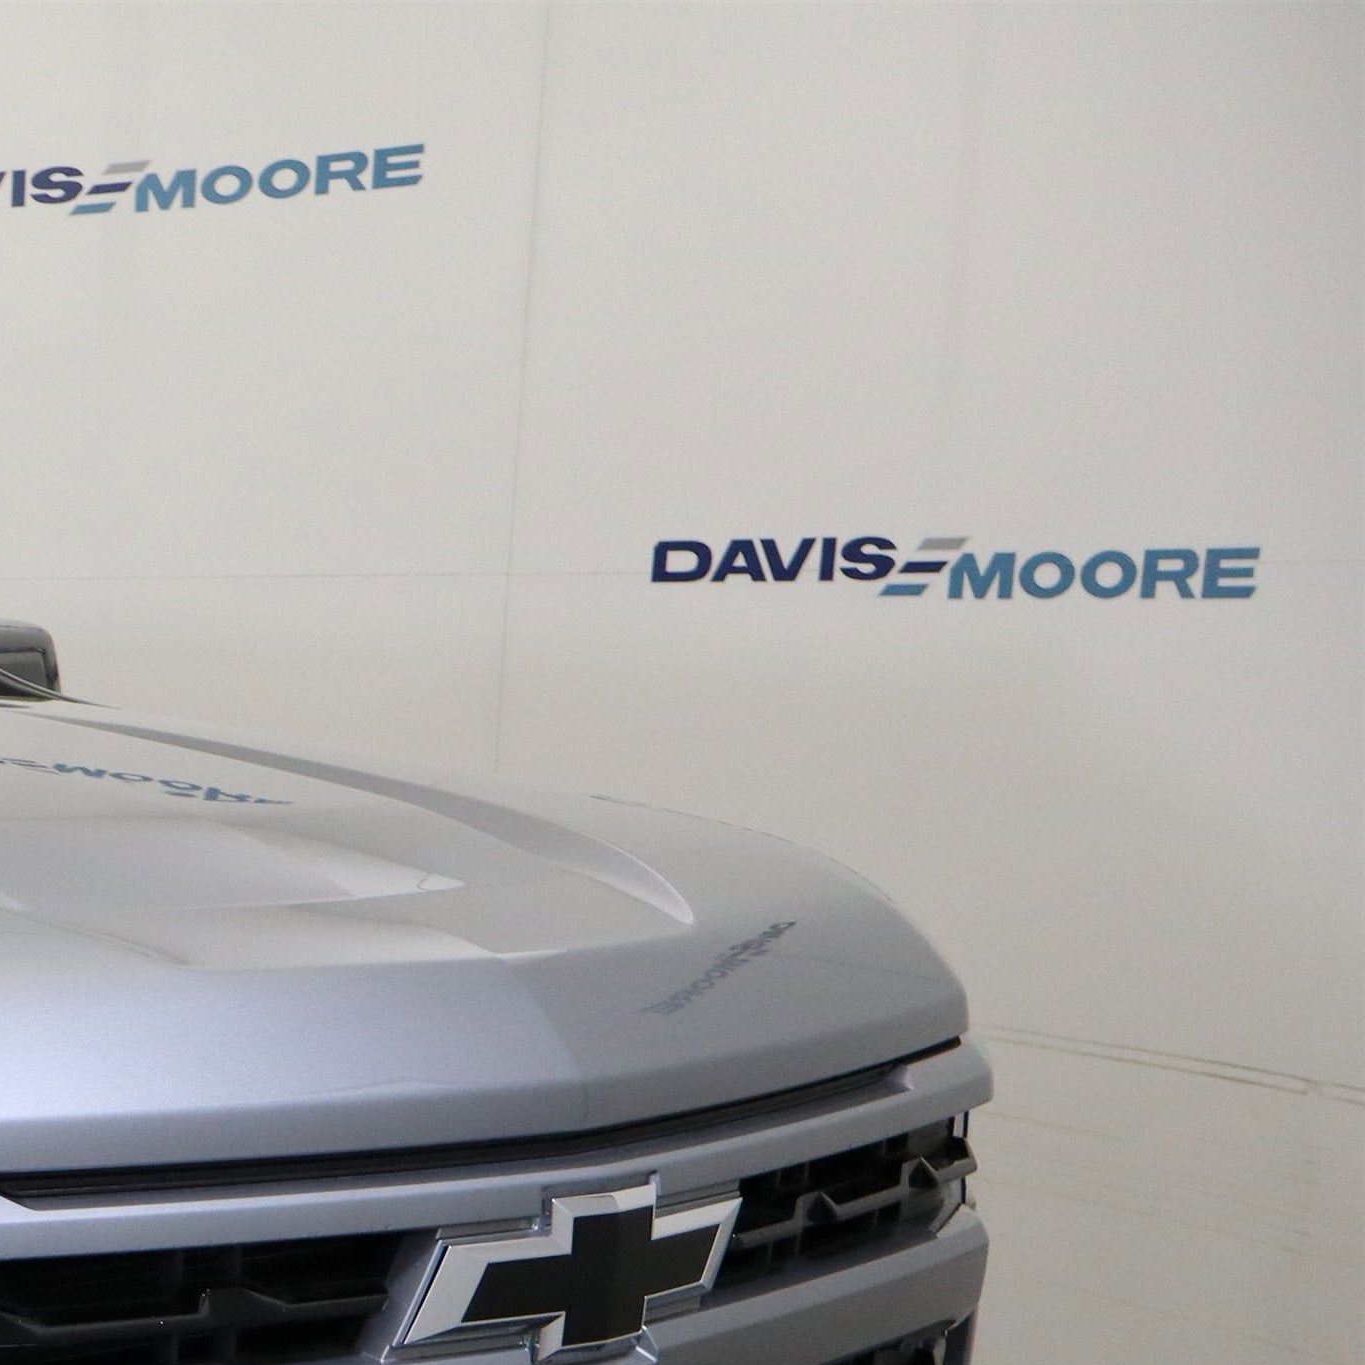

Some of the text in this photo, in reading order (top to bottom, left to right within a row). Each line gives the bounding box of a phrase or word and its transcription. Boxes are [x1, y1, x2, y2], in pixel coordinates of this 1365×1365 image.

[134, 143, 425, 213] MOORE
[650, 535, 1261, 600] DAVIS MOORE
